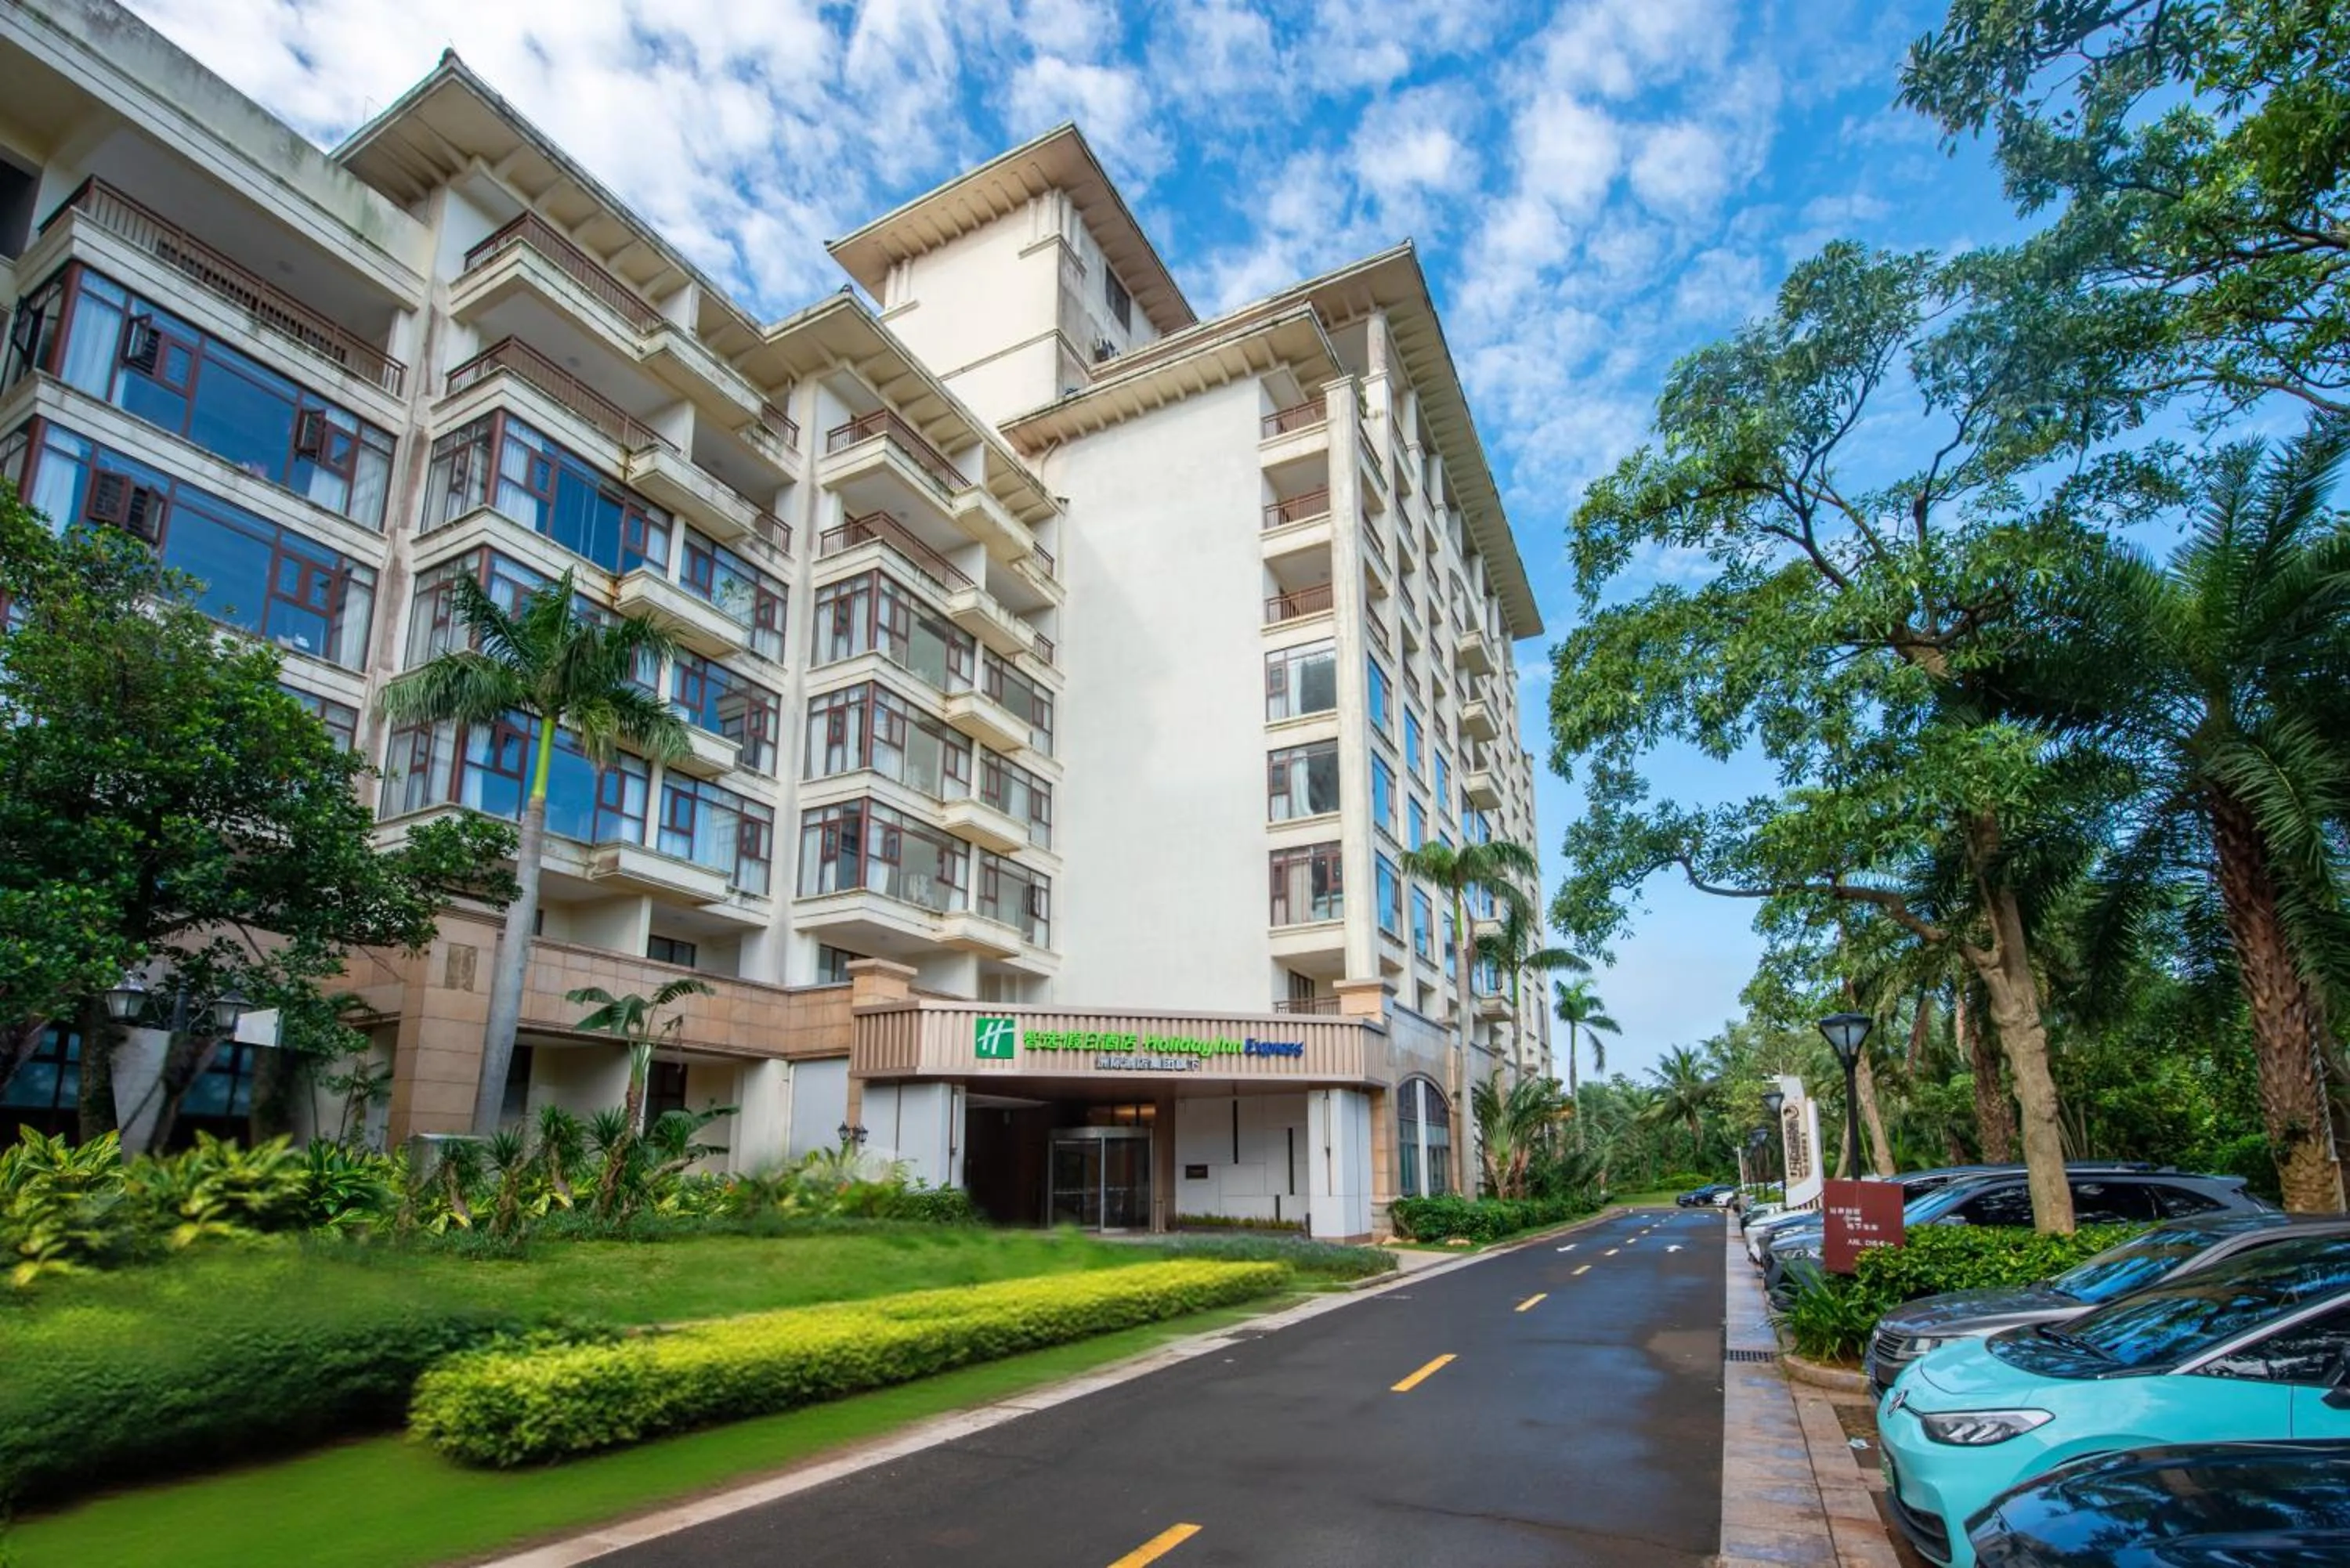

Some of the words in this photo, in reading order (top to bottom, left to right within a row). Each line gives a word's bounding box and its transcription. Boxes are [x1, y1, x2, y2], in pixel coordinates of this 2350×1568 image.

[1024, 1030, 1137, 1052] 智选假日酒店
[1143, 1031, 1214, 1057] Holiday
[1215, 1035, 1243, 1054] Inn
